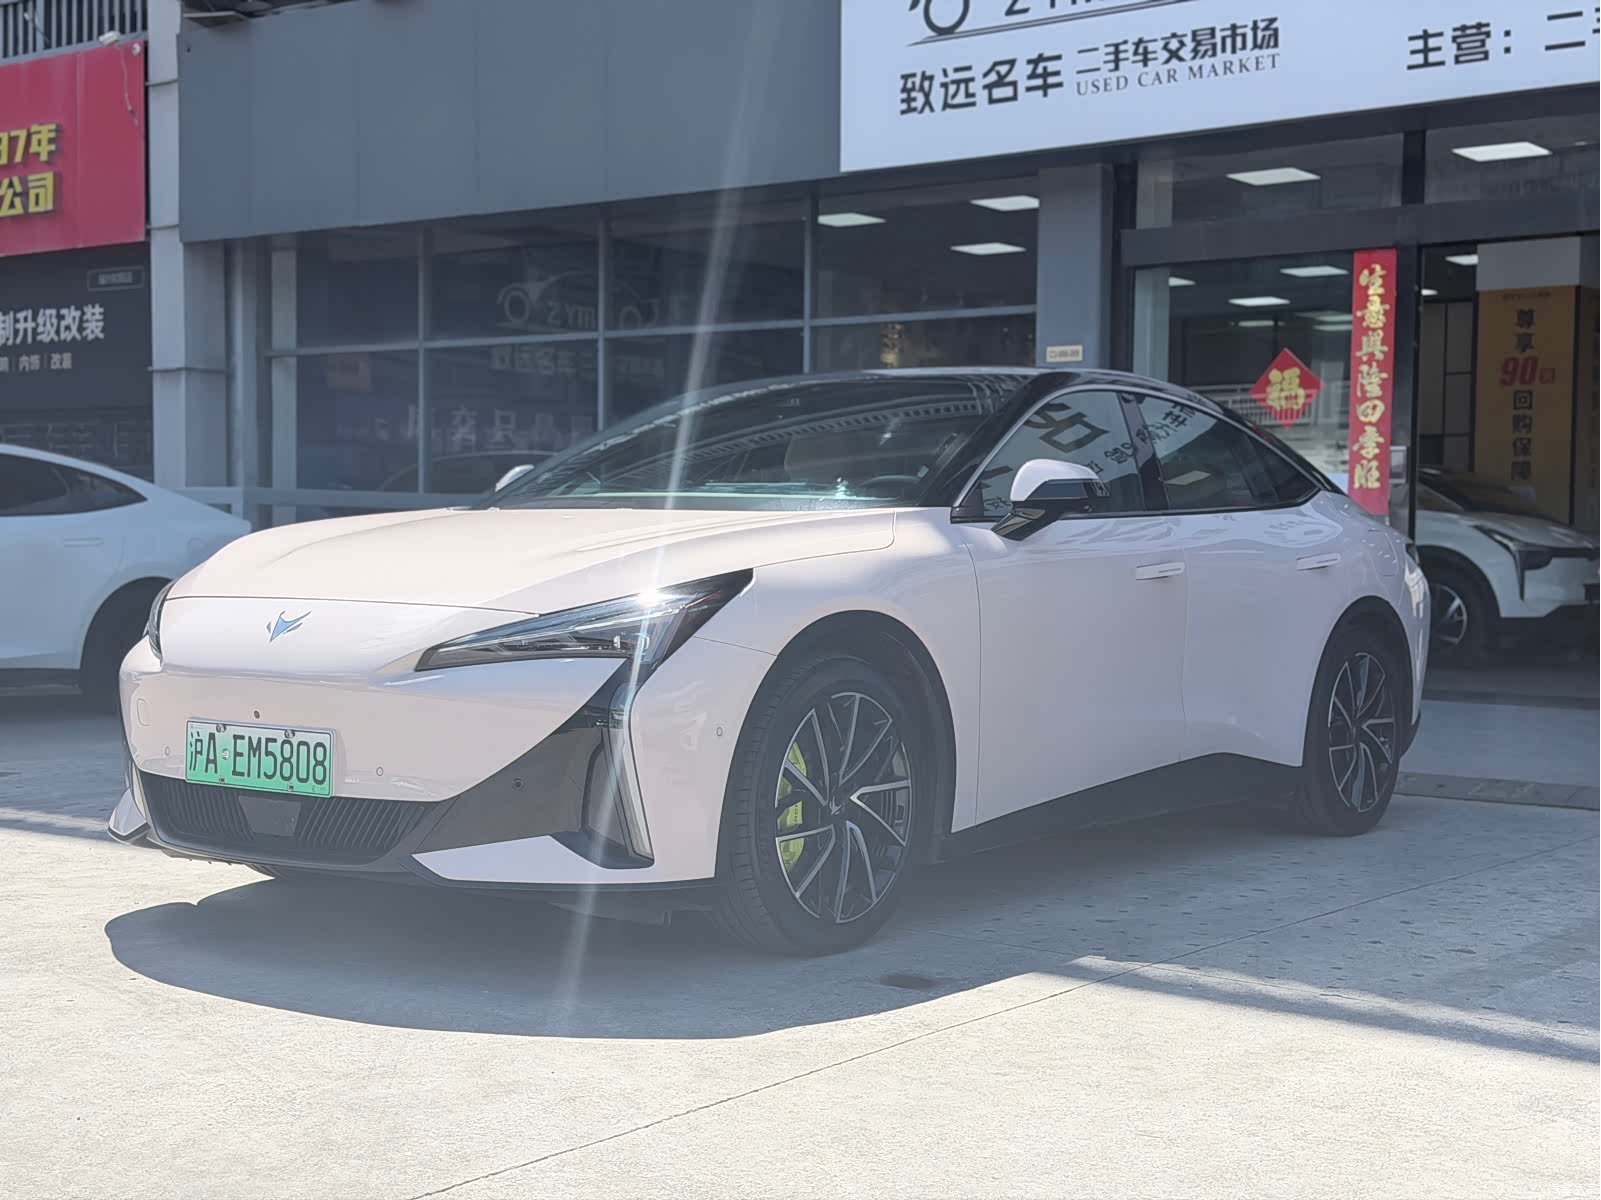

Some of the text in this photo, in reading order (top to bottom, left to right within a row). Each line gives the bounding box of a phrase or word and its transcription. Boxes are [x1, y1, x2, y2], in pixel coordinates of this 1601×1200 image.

[1075, 16, 1280, 74] 二手车交易市场
[1406, 8, 1601, 70] 主营：二
[899, 53, 1064, 115] 致远名车
[1076, 53, 1280, 96] USED CAR MARKET
[0, 171, 54, 217] 公司
[1266, 366, 1306, 412] 福
[231, 734, 328, 786] EM5808
